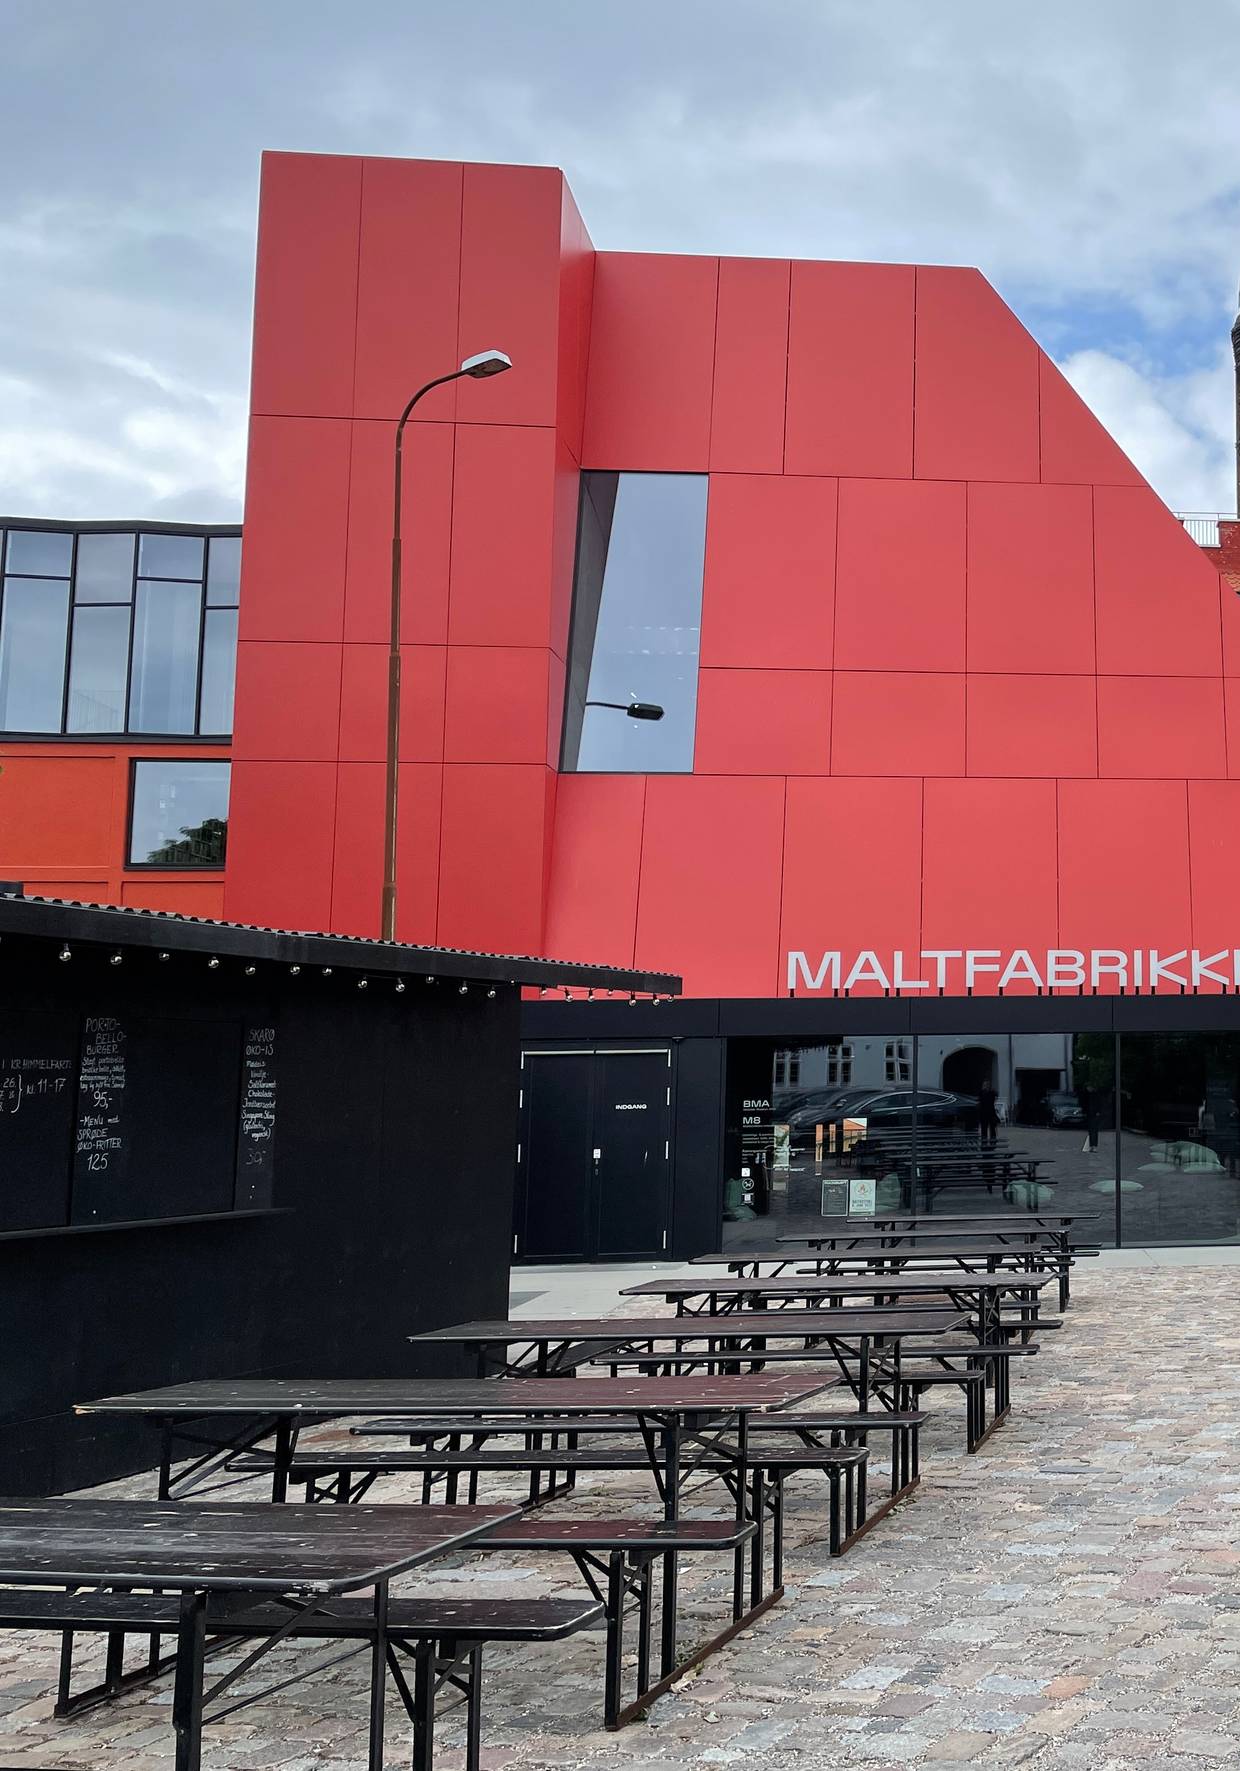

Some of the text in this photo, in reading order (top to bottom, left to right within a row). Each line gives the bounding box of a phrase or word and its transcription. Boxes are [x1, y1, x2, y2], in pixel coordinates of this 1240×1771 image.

[743, 1099, 770, 1108] BMA
[742, 1116, 761, 1125] M8
[87, 1153, 110, 1171] 125
